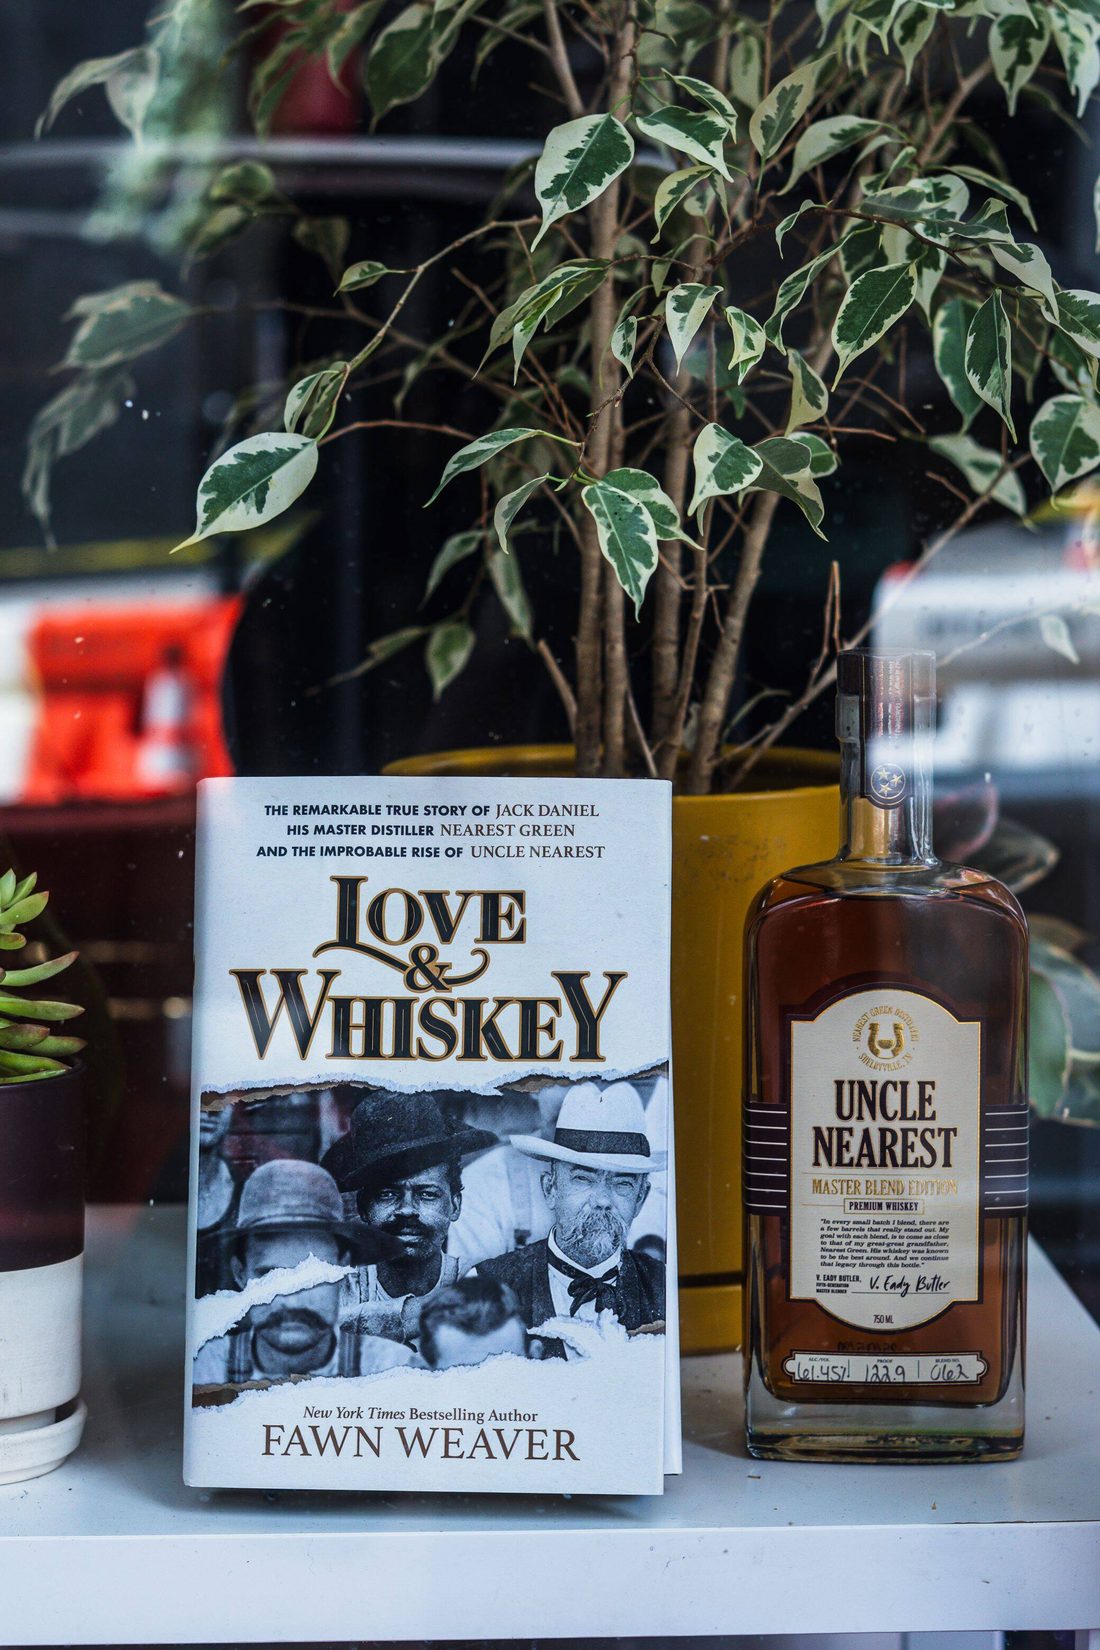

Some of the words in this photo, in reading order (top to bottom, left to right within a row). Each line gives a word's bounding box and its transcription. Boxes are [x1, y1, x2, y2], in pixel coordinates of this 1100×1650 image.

[265, 805, 289, 816] THE
[293, 804, 382, 816] REMARKABLE
[386, 805, 419, 816] TRUE
[423, 805, 467, 817] STORY
[471, 805, 490, 817] OF
[496, 804, 534, 820] JACK
[538, 804, 600, 817] DANIEL
[287, 825, 309, 836] HIS
[313, 824, 367, 836] MASTER
[371, 825, 434, 836] DISTILLER
[440, 824, 516, 837] NEAREST
[519, 824, 575, 837] GREEN
[256, 846, 288, 857] AND
[292, 846, 316, 857] THE
[320, 846, 407, 858] IMPROBABLE
[411, 847, 440, 858] RISE
[444, 847, 463, 858] OF
[470, 845, 525, 858] UNCLE
[529, 845, 606, 859] NEAREST
[404, 943, 453, 993] &
[834, 1080, 937, 1121] UNCLE
[812, 1126, 958, 1169] NEAREST
[812, 1179, 861, 1195] MASTER
[865, 1179, 905, 1196] BLEND
[908, 1180, 959, 1197] EDITION
[849, 1202, 883, 1211] PREMIUM
[885, 1202, 919, 1211] WHISKEY
[839, 1275, 862, 1283] BUTLER,
[870, 1276, 879, 1289] V.
[884, 1275, 911, 1297] Eady
[915, 1274, 950, 1292] Butler
[873, 1315, 885, 1324] 750
[886, 1315, 894, 1324] ML
[865, 1364, 905, 1383] 122.9
[930, 1364, 969, 1381] 062
[303, 1406, 332, 1419] New
[336, 1406, 364, 1419] York
[368, 1407, 405, 1420] Times
[409, 1408, 485, 1425] Bestselling
[488, 1409, 538, 1422] Author
[261, 1424, 383, 1458] FAWN
[395, 1426, 580, 1461] WEAVER
